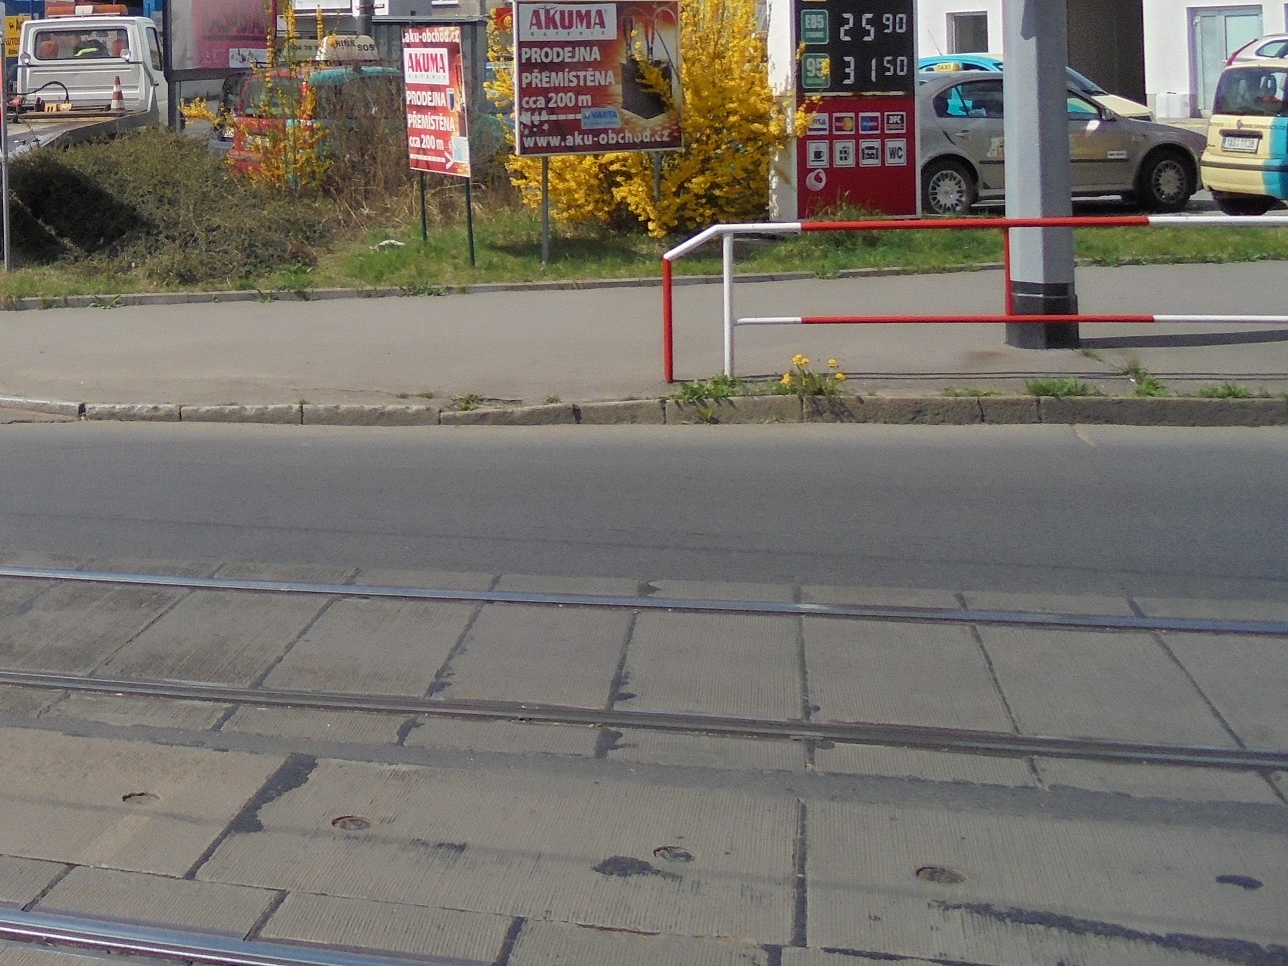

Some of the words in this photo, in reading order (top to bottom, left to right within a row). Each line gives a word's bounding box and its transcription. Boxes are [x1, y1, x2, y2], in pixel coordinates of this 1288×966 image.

[529, 9, 606, 30] AKUMA
[839, 13, 874, 41] 25
[882, 14, 907, 33] 90
[408, 53, 446, 73] AKUMA
[521, 47, 601, 63] PRODEJNA
[883, 56, 908, 75] 50
[521, 68, 616, 88] PŘEMÍSTĚNA
[406, 91, 446, 107] PRODEJNA
[521, 97, 545, 108] cca
[547, 93, 576, 107] 200
[578, 96, 592, 106] m
[407, 112, 455, 132] PŘEMÍSTĚNA
[591, 111, 618, 119] VARTA
[409, 138, 421, 148] cca
[421, 134, 435, 149] 200
[436, 141, 444, 150] m
[889, 146, 903, 159] WC
